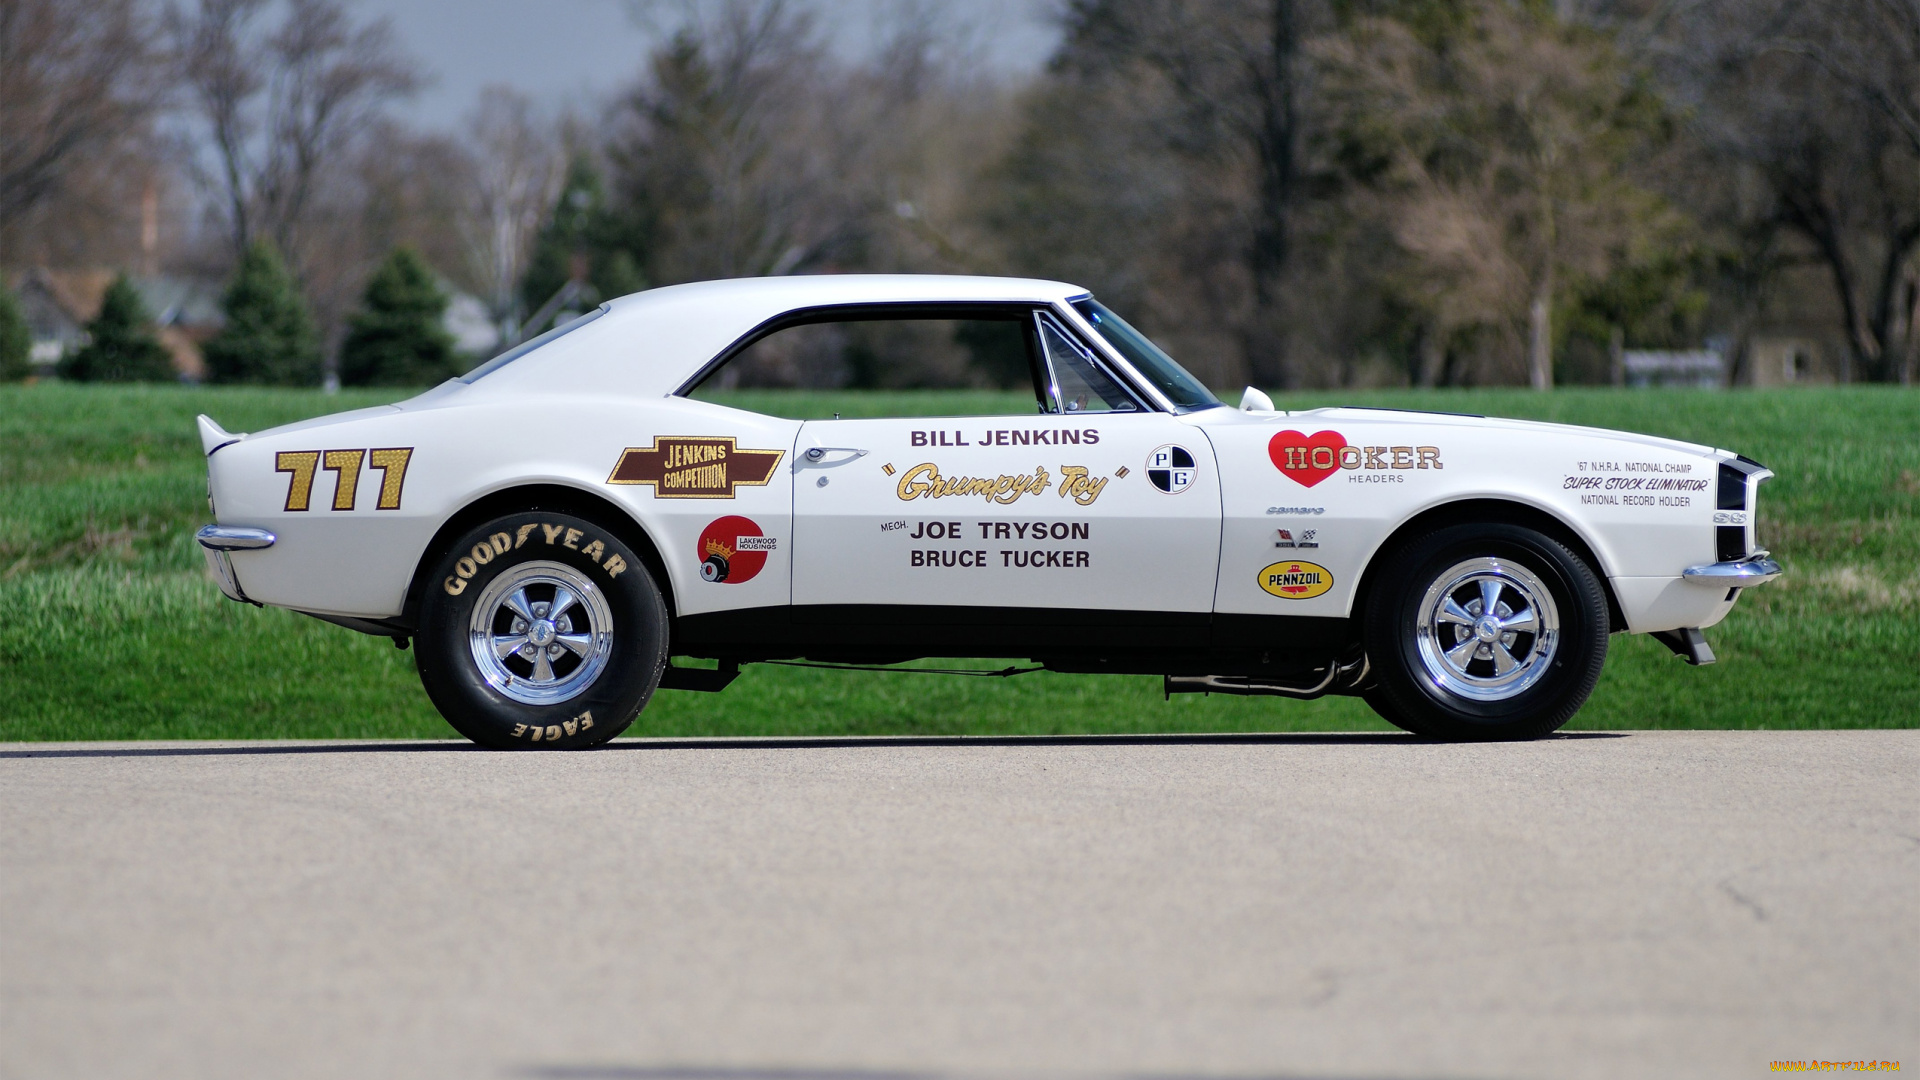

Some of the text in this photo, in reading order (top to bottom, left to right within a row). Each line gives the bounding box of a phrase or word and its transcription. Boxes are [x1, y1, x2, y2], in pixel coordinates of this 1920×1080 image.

[911, 429, 1100, 447] BILL JENKINS
[664, 445, 727, 469] JENKINS
[1156, 453, 1167, 466] P
[1284, 446, 1443, 470] HOOKER
[1577, 462, 1692, 474] '67 N.H.R.A. NATIONAL CHAMP
[275, 447, 415, 512] 777
[664, 463, 727, 489] COMPETITION
[1175, 472, 1187, 485] G
[1348, 475, 1404, 483] HEADERS
[1605, 478, 1645, 490] STOCK
[1581, 495, 1690, 507] NATIONAL RECORD HOLDER
[1713, 512, 1747, 524] SS
[881, 521, 1089, 540] MECH. JOE TRYSON
[739, 537, 777, 545] LAKEWOOD
[444, 523, 627, 596] GOODYEAR
[911, 550, 1089, 567] BRUCE TUCKER
[1268, 572, 1322, 586] PENNZOIL
[510, 710, 594, 741] EAGLE
